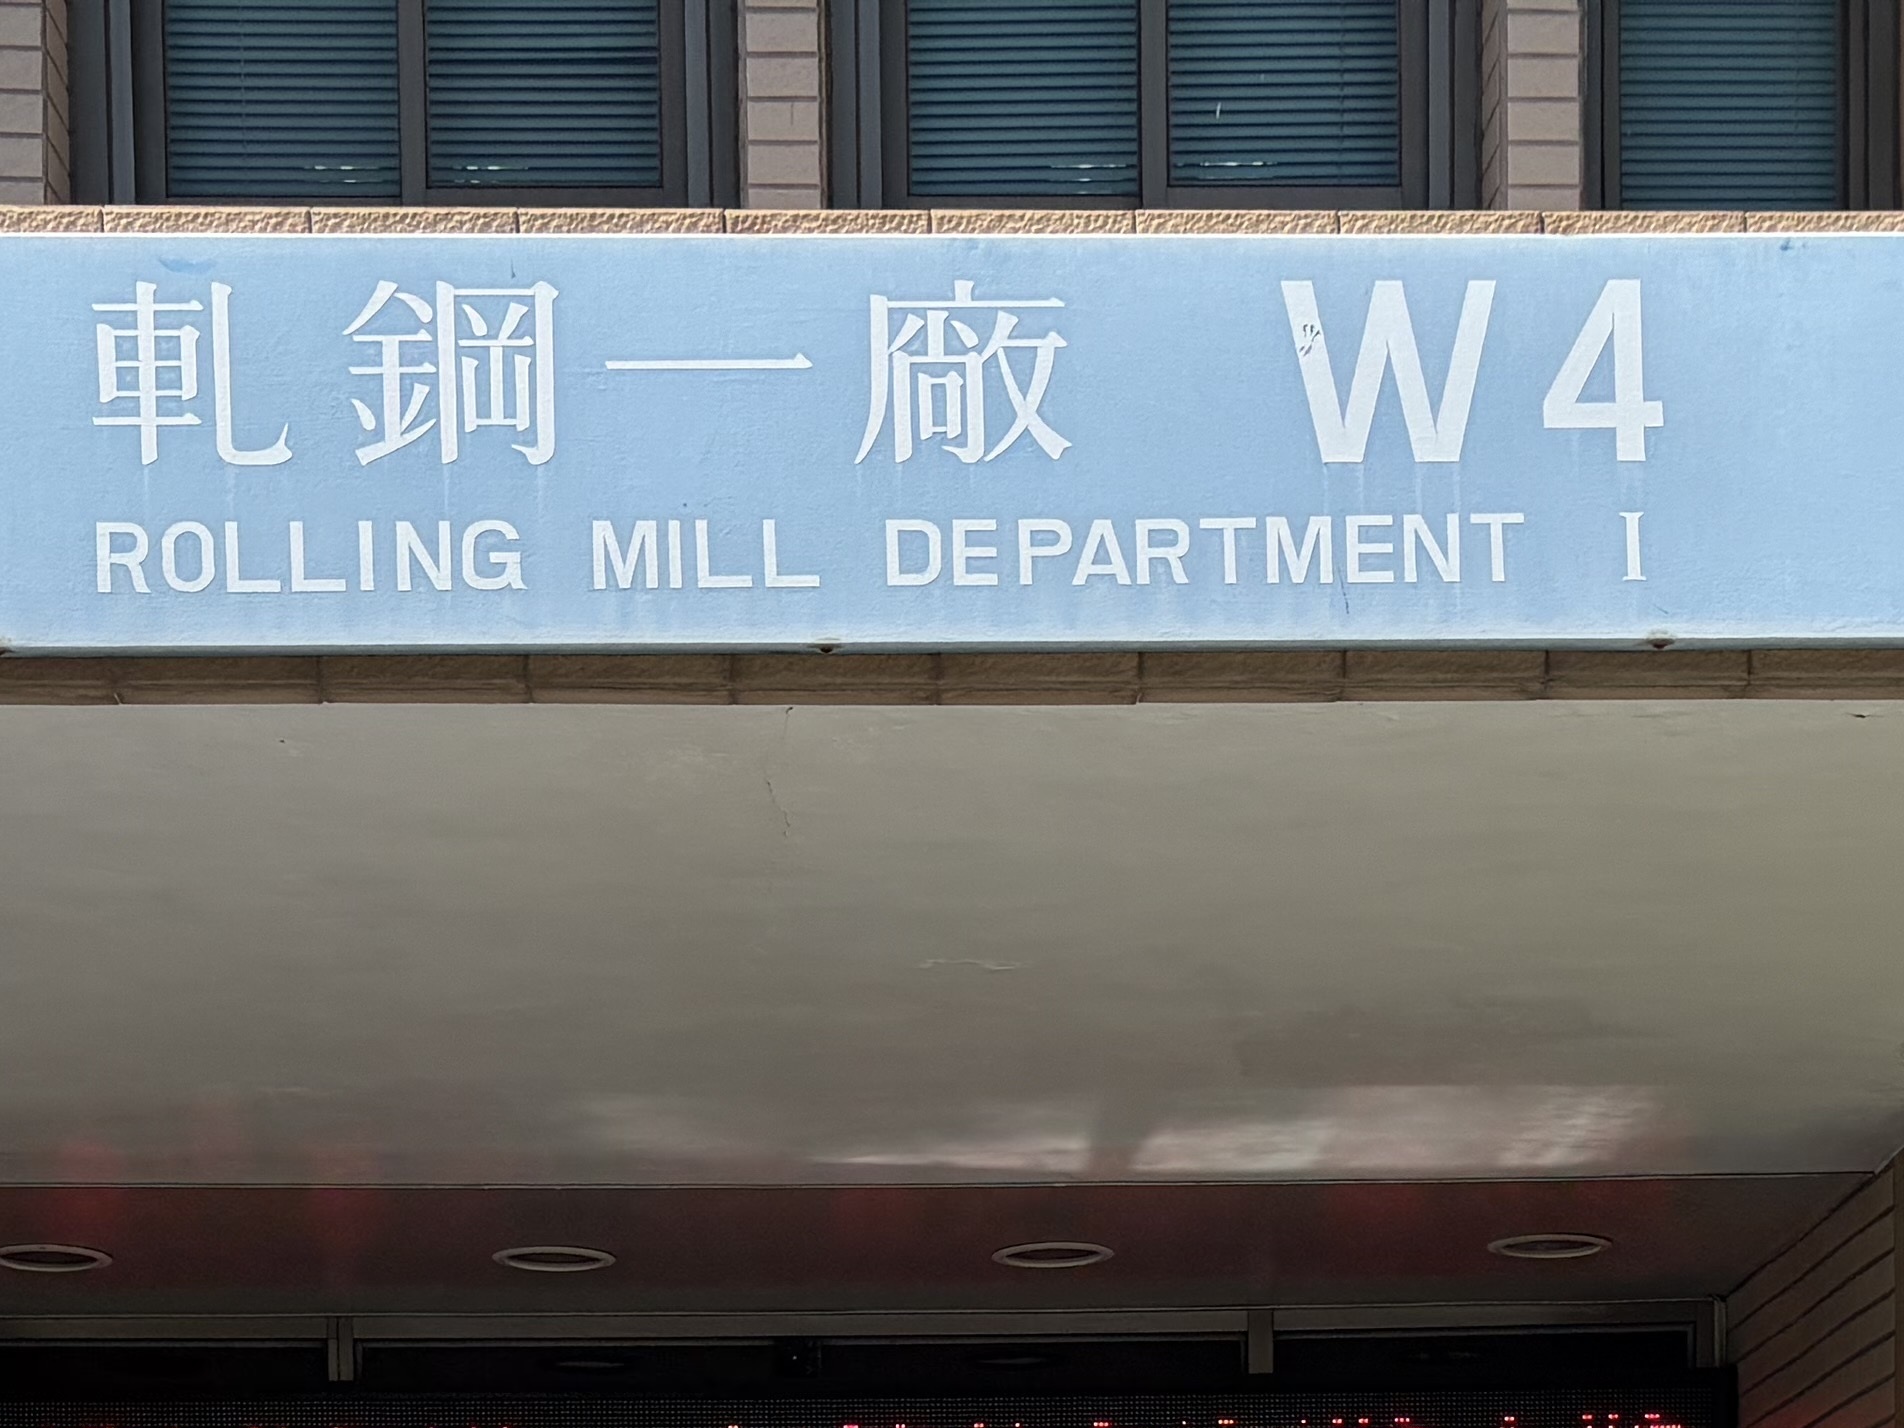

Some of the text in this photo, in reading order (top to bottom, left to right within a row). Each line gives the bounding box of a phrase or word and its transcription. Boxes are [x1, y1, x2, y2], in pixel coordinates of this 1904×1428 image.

[92, 279, 1072, 466] 軋鋼一廠
[95, 511, 1646, 595] ROLLING MILL DEPARTMENT I
